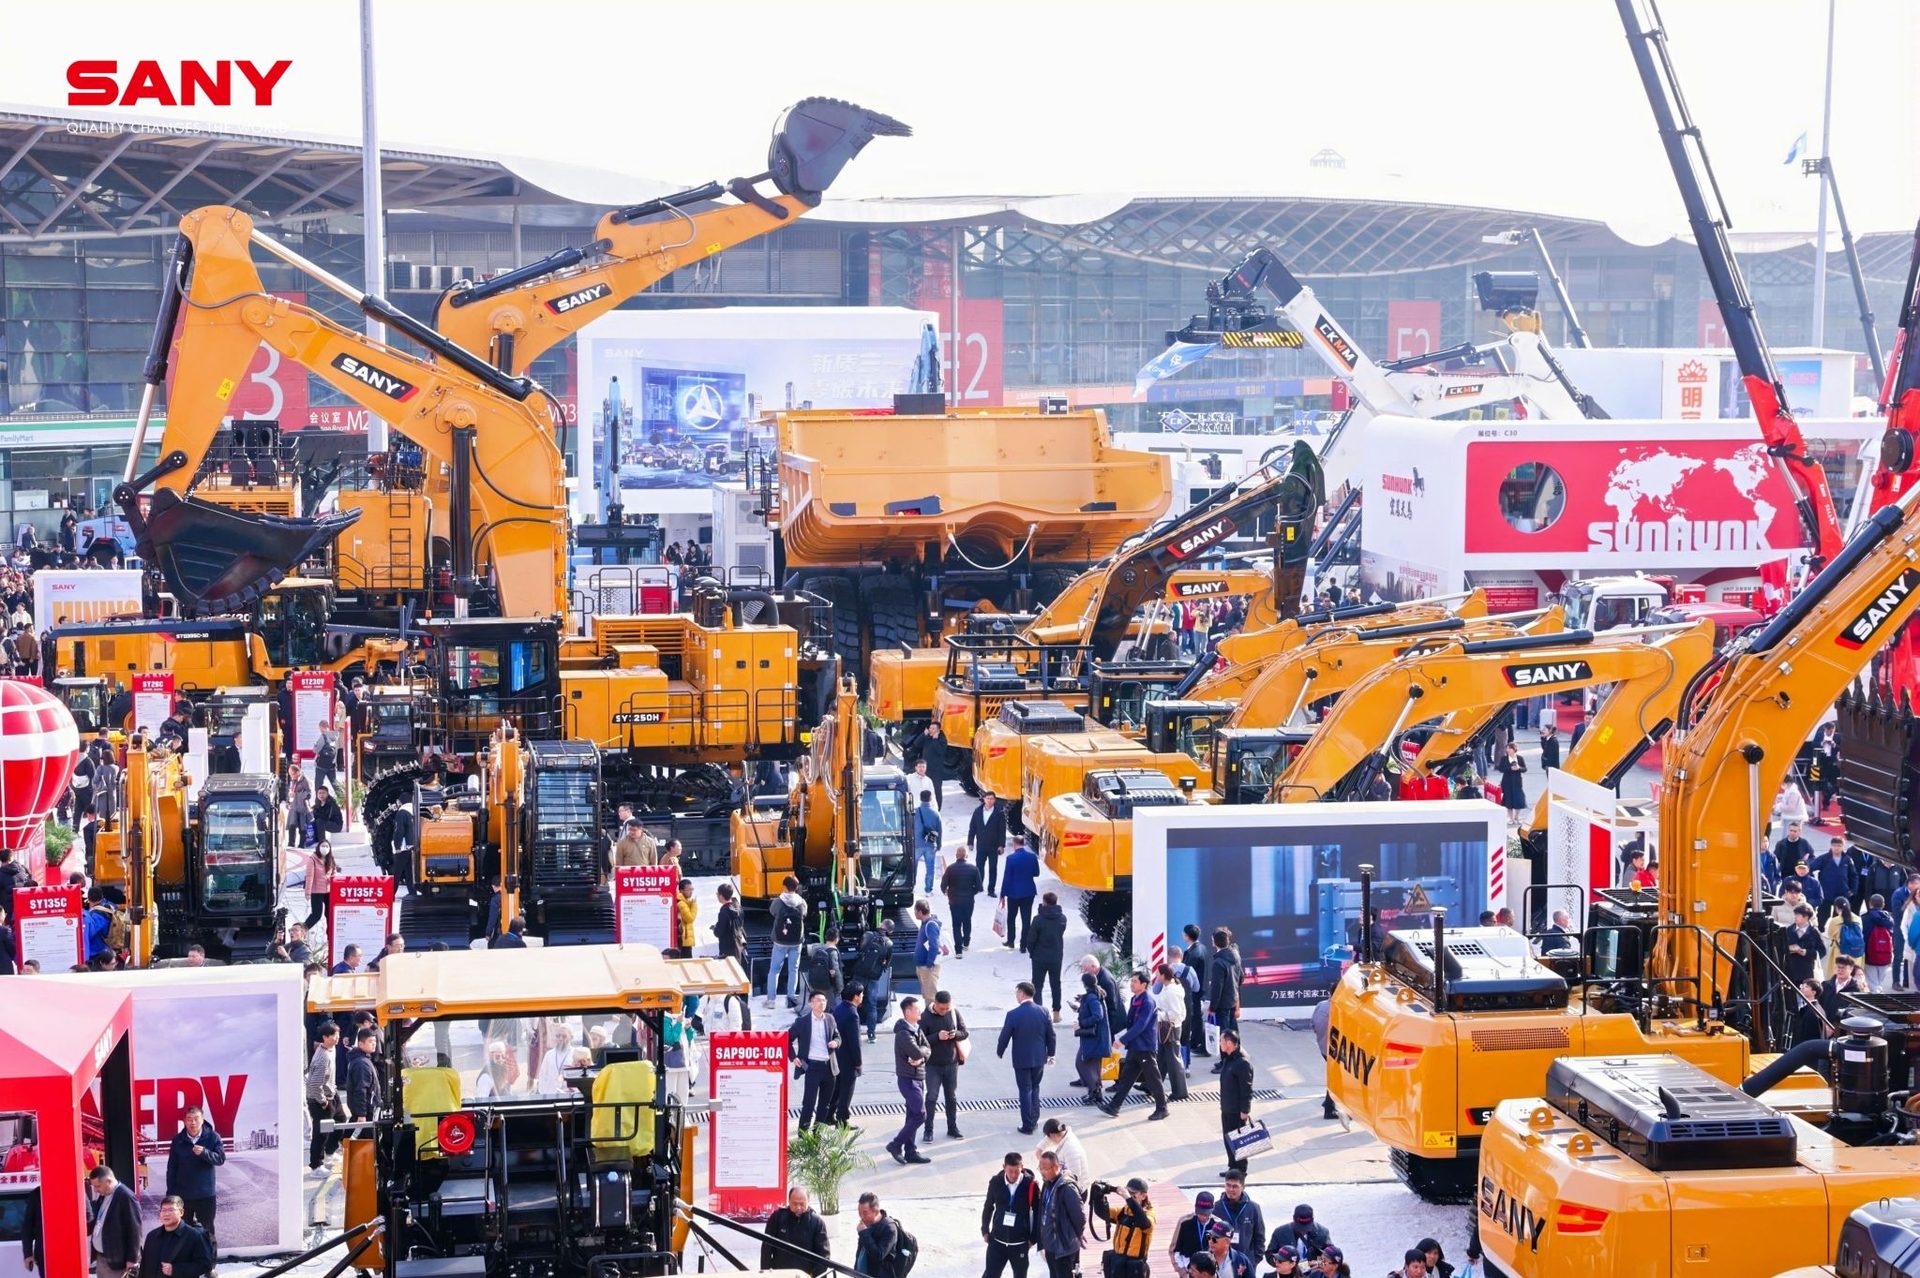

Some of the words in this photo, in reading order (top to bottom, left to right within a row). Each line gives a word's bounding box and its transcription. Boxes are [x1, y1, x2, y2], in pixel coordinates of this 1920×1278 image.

[557, 285, 602, 312] SANY
[1319, 323, 1355, 362] CKMM
[340, 357, 401, 395] SANY
[941, 334, 990, 400] E2
[1449, 385, 1479, 395] CKMM
[309, 411, 341, 423] 会议室
[1180, 521, 1224, 553] SANY
[1181, 582, 1222, 595] SANY
[1851, 574, 1909, 641] SANY
[1515, 662, 1581, 686] SANY
[340, 887, 384, 898] SY135F-5
[658, 876, 671, 886] PB
[29, 897, 68, 910] SY135C
[715, 1046, 784, 1060] SAP90C-10A
[1328, 1025, 1376, 1086] SANY
[1480, 1175, 1546, 1254] SANY
